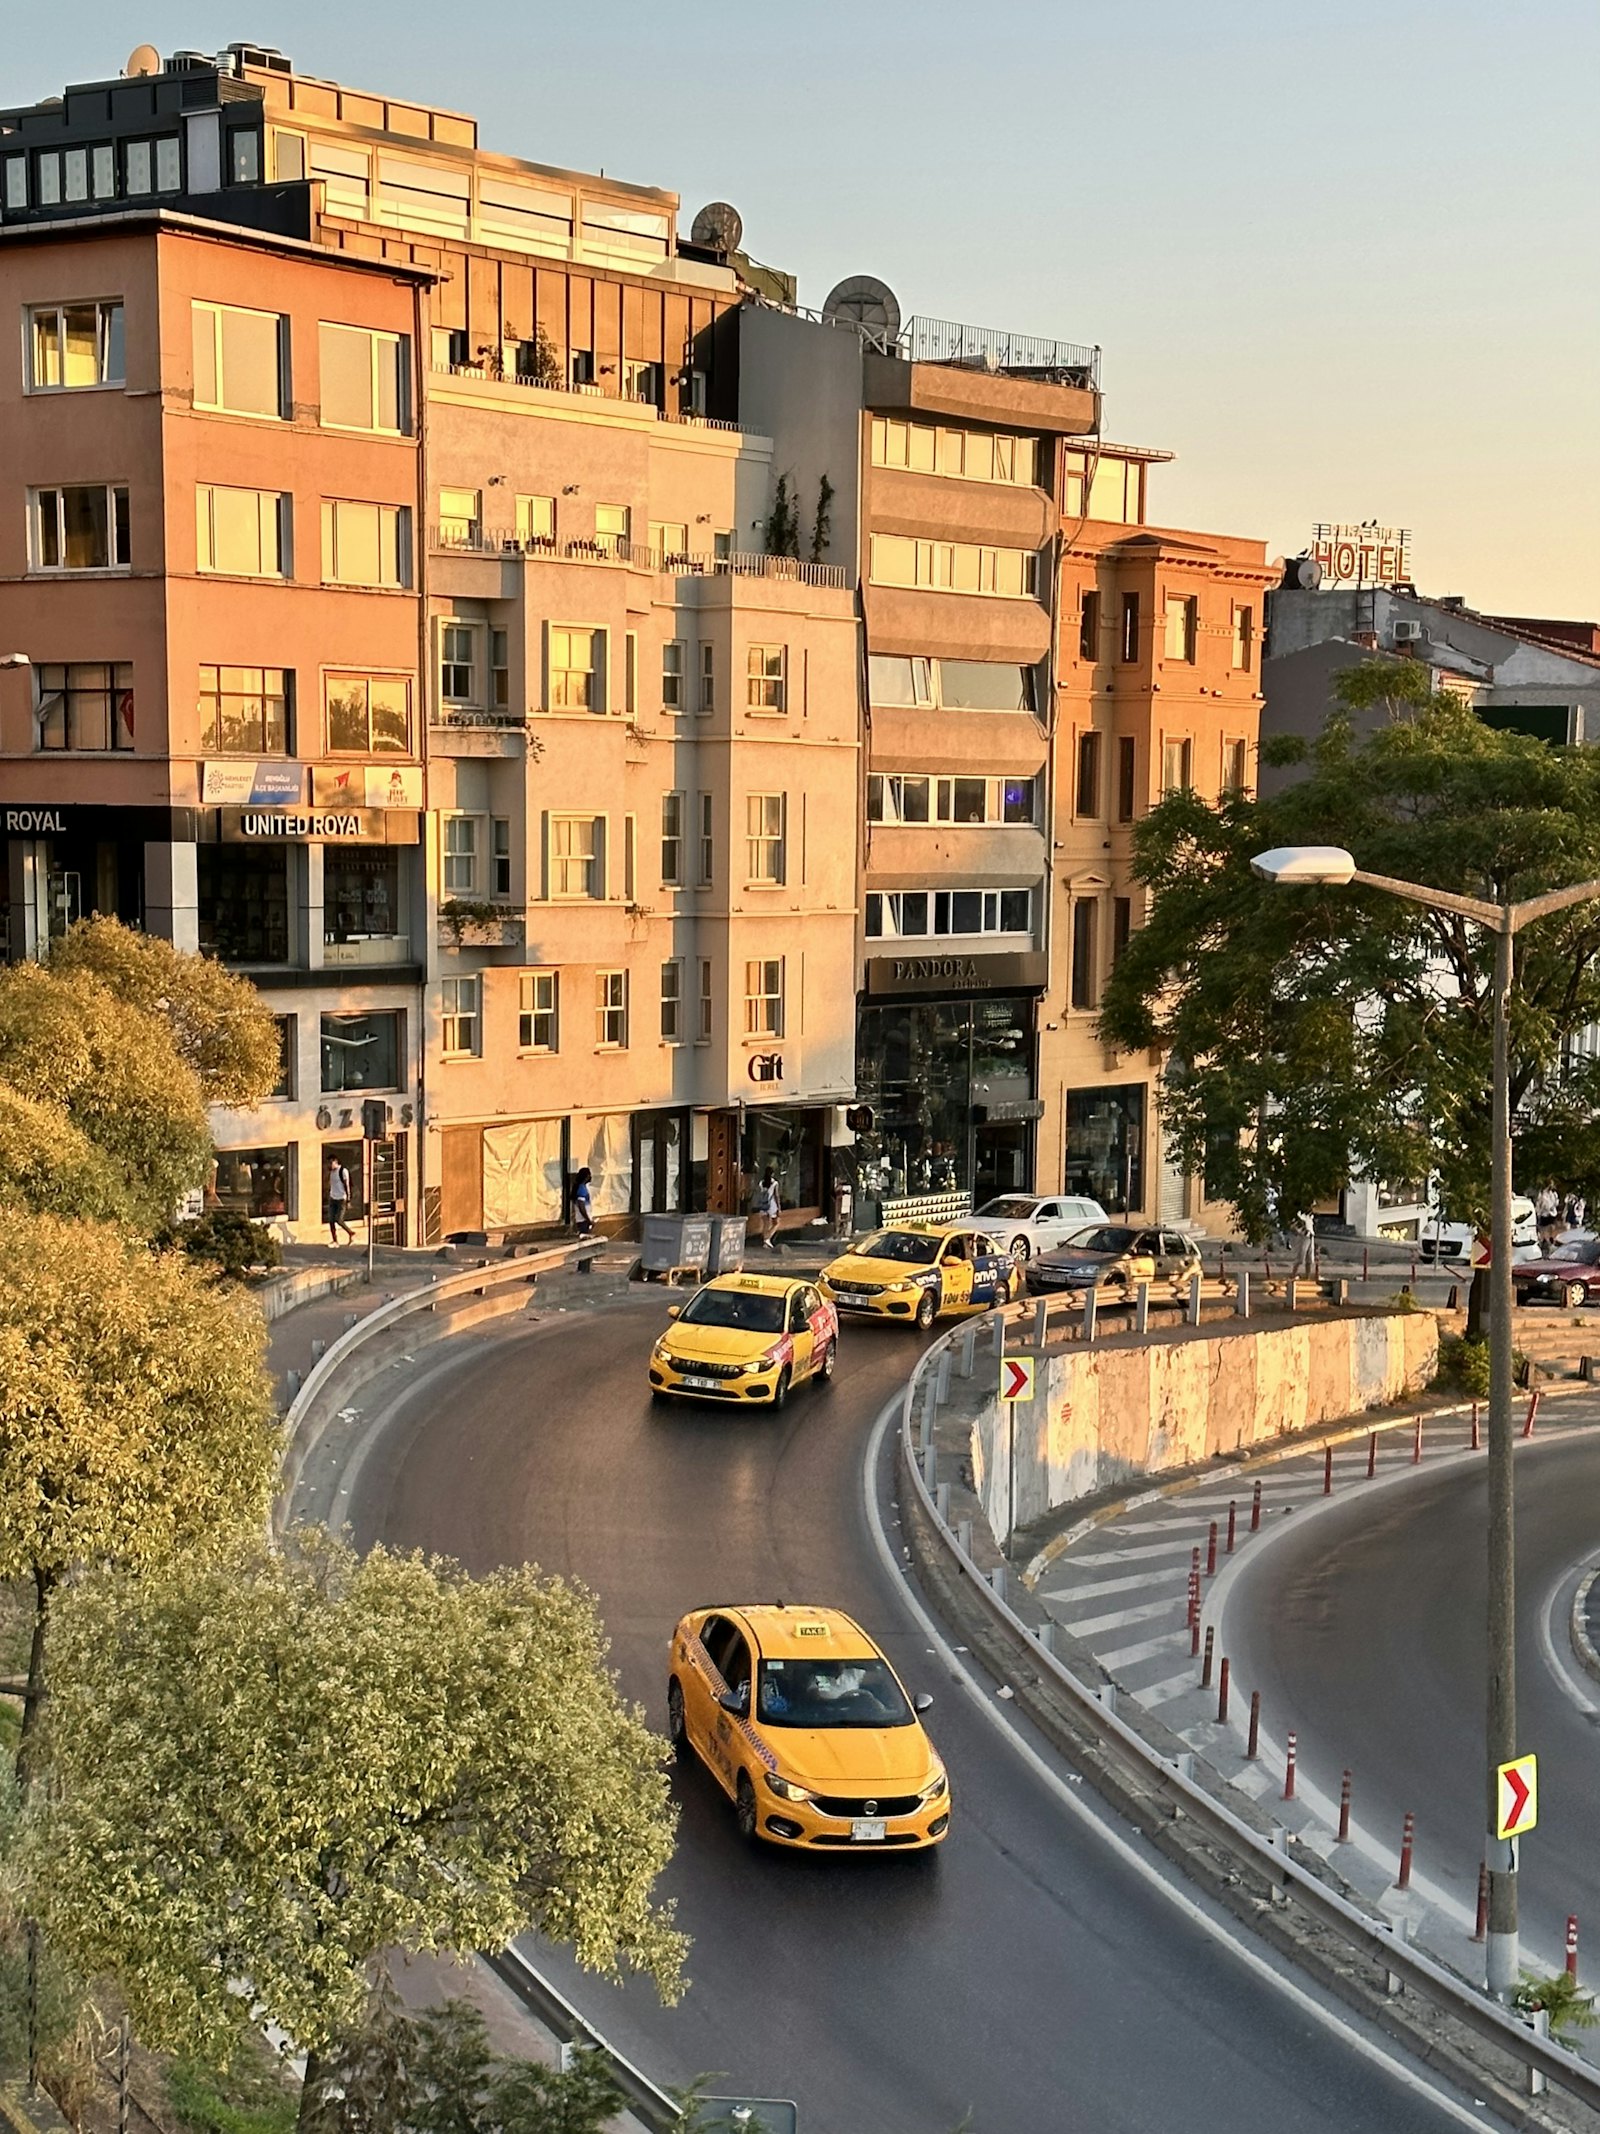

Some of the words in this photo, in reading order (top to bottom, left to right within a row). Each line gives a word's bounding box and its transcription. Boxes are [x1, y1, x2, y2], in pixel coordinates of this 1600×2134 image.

[1315, 541, 1411, 581] HOTEL
[6, 811, 67, 832] ROYAL
[245, 815, 309, 835] UNITED
[314, 815, 368, 835] ROYAL
[895, 959, 977, 980] PANDORA
[748, 1053, 783, 1082] Gift
